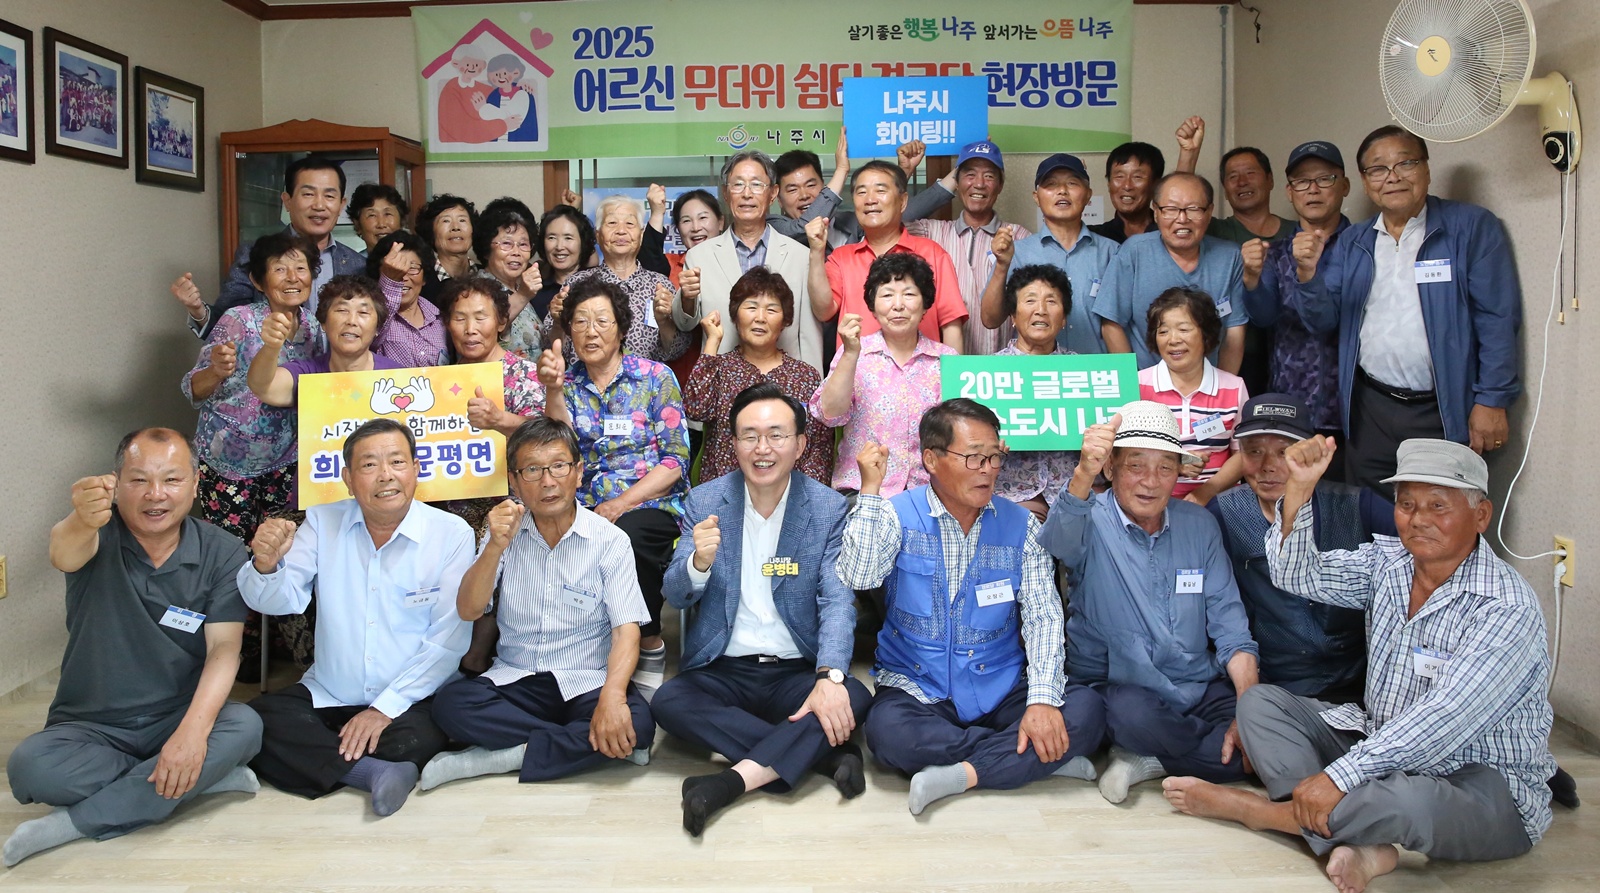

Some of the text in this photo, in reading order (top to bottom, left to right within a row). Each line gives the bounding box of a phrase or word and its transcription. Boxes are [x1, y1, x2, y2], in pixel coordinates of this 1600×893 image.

[848, 17, 1114, 42] 살기 좋은 행복 나주 앞서가는 으뜸 나주
[572, 26, 655, 60] 2025
[573, 65, 676, 113] 어르신
[683, 63, 785, 111] 무더위
[981, 61, 1118, 108] 현장방문
[883, 90, 949, 115] 나주시
[767, 130, 825, 145] 나주시
[876, 120, 956, 146] 화이팅!!
[959, 370, 1121, 400] 20만 글로벌
[761, 562, 799, 577] 윤병태
